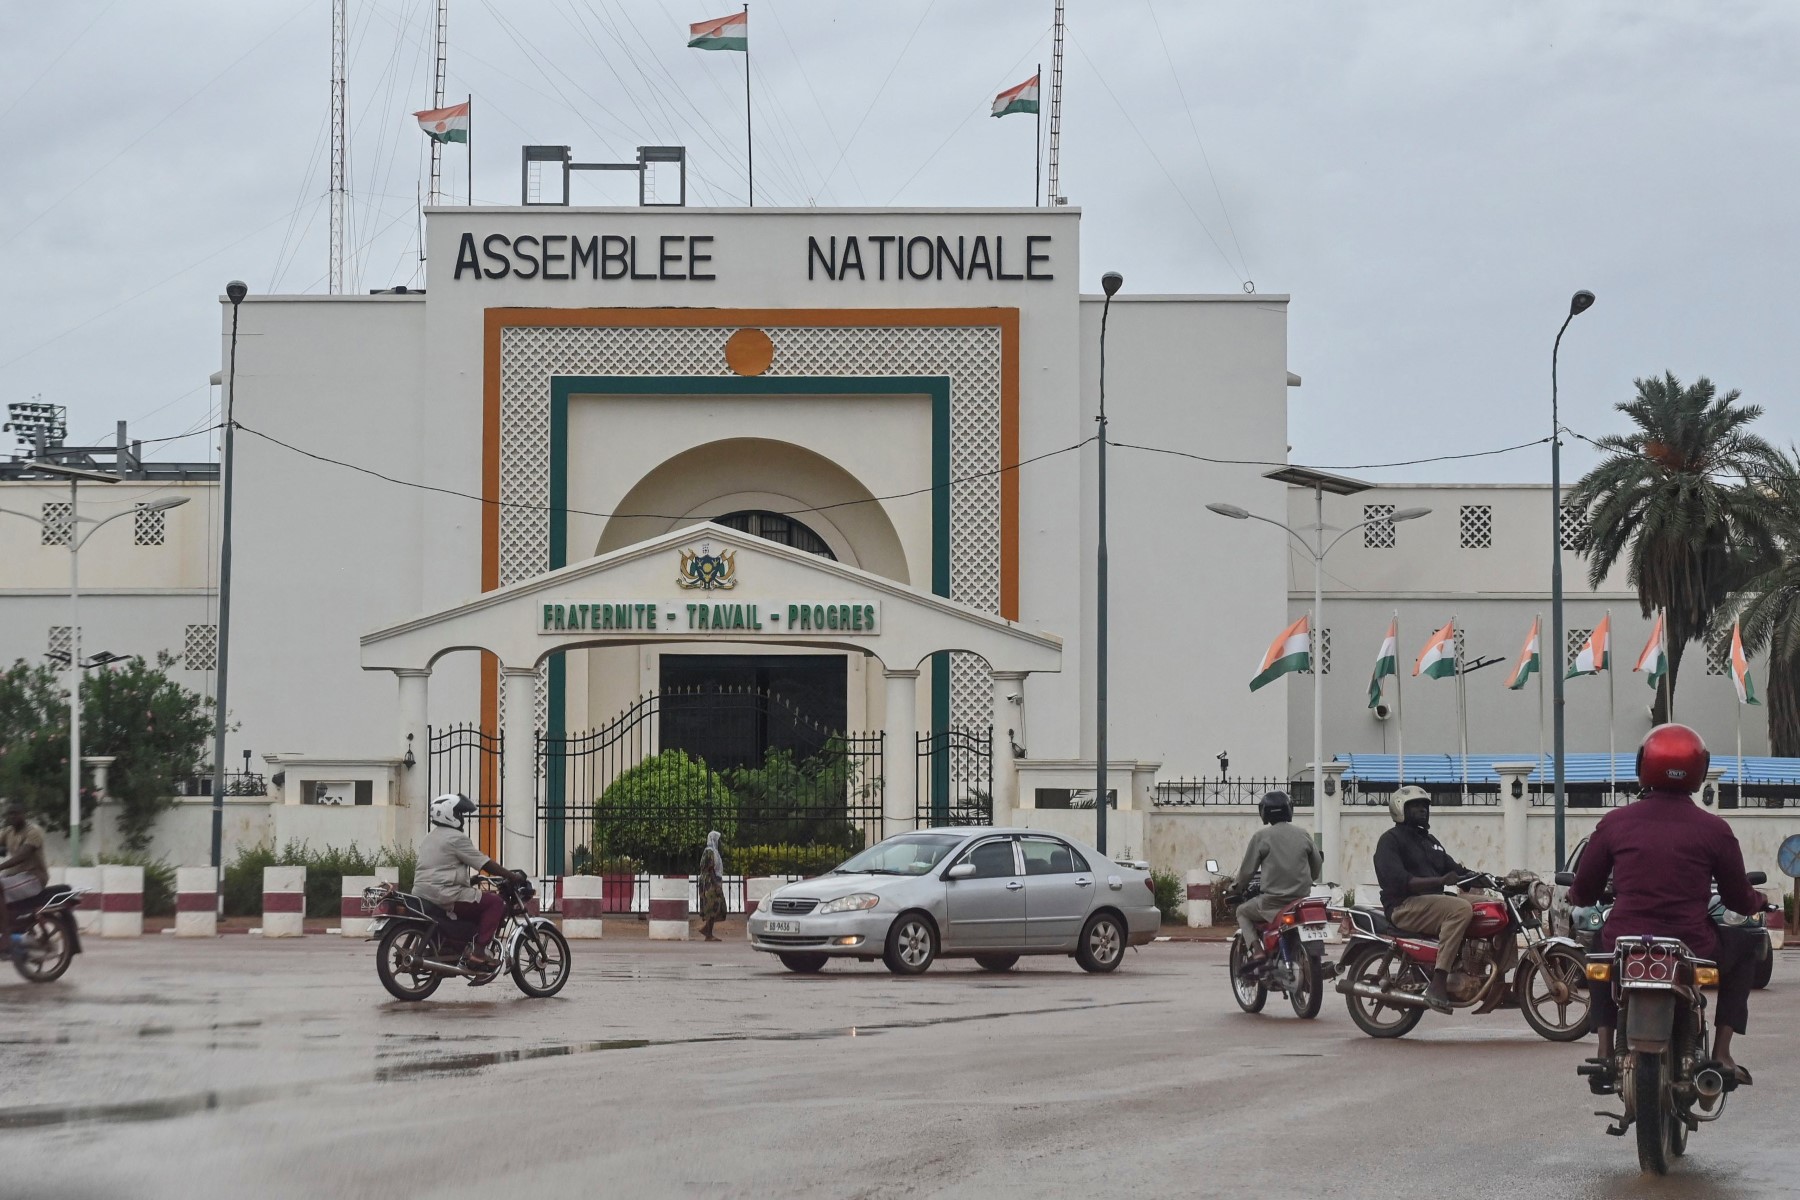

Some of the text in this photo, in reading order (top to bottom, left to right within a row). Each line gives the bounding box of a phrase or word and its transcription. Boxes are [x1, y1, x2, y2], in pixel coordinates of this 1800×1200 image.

[453, 232, 1054, 281] ASSEMBLEE NATIONALE
[543, 604, 657, 629] FRATERNITE
[687, 604, 762, 630] TRAVAIL
[788, 604, 875, 630] PROGRES
